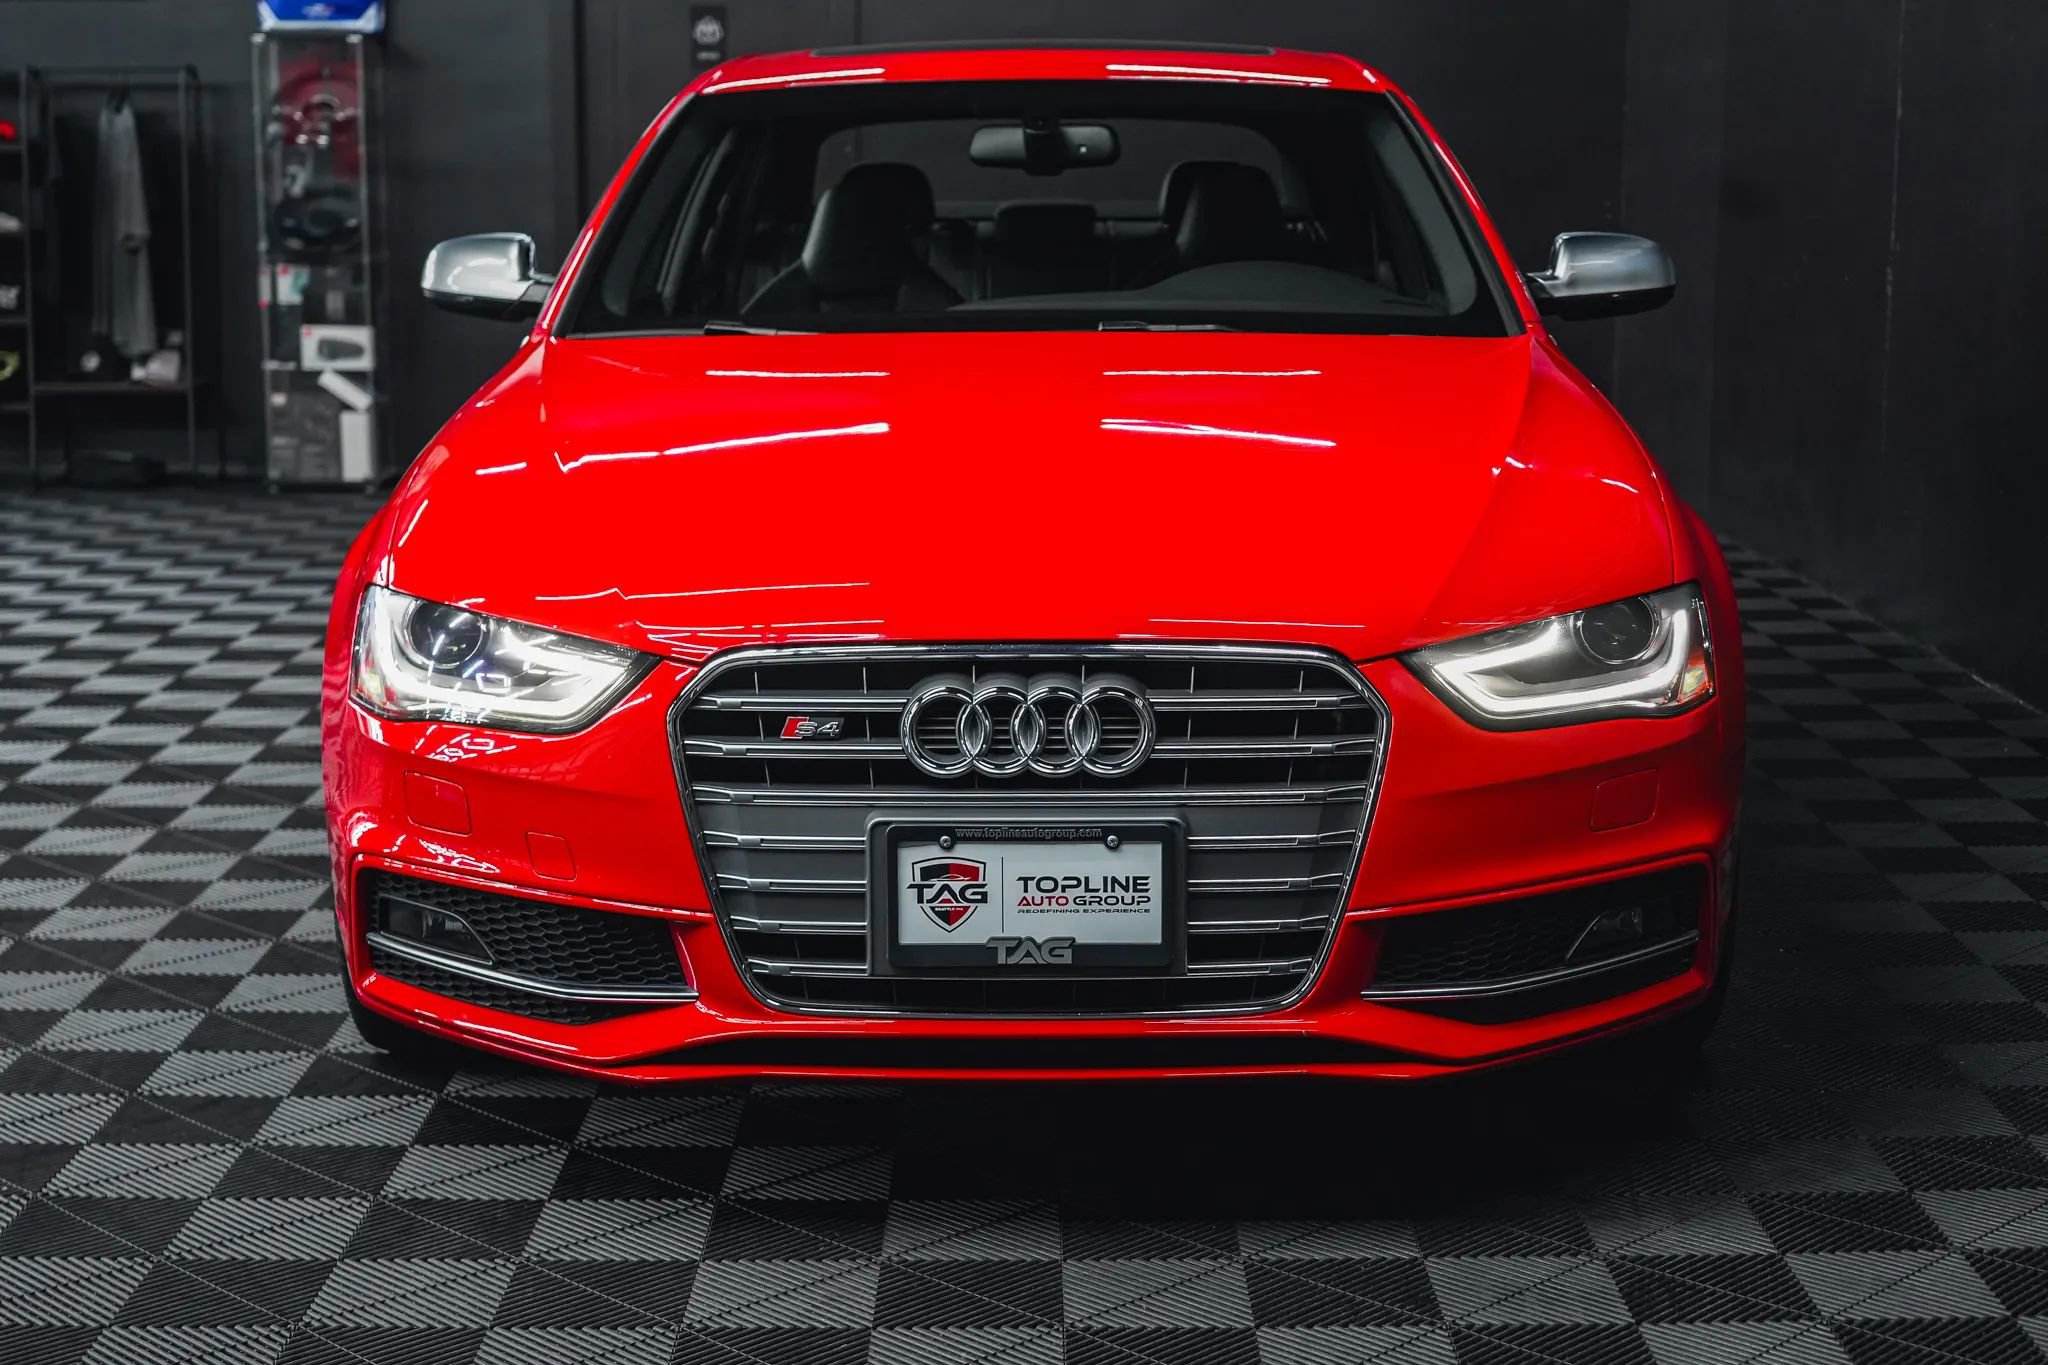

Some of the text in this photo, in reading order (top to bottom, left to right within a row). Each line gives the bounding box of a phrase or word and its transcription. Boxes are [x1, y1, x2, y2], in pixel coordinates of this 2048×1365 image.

[794, 721, 840, 737] S4
[955, 827, 1103, 840] www.toplineautogroup.com
[1016, 876, 1151, 893] TOPLINE
[906, 883, 988, 904] TAG
[1017, 895, 1151, 906] AUTO GROUP
[985, 938, 1073, 965] TAG
